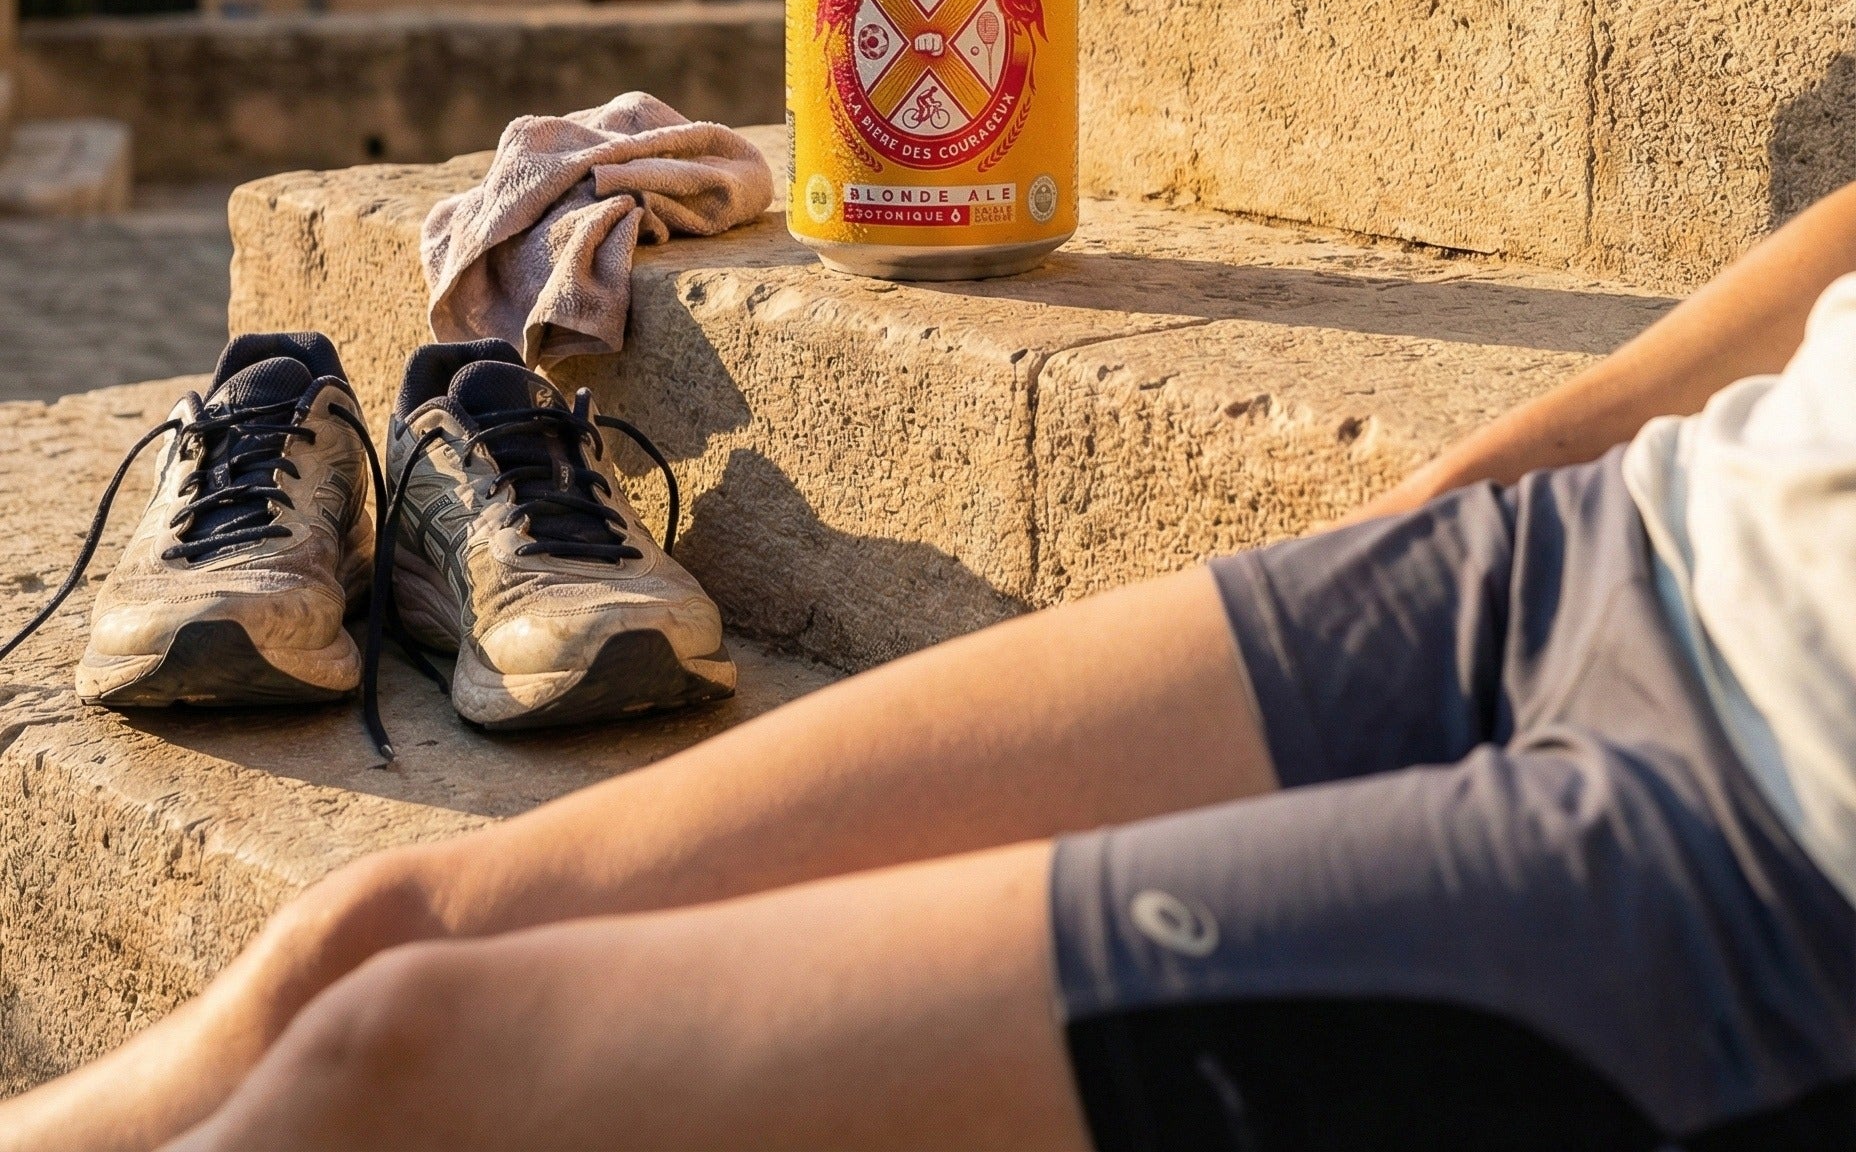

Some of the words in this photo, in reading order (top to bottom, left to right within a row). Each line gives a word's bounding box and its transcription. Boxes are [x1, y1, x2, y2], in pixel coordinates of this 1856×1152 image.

[902, 145, 932, 160] DES
[939, 93, 1015, 159] COURAGEUX
[850, 188, 949, 203] BLONDE
[968, 188, 1010, 202] ALE
